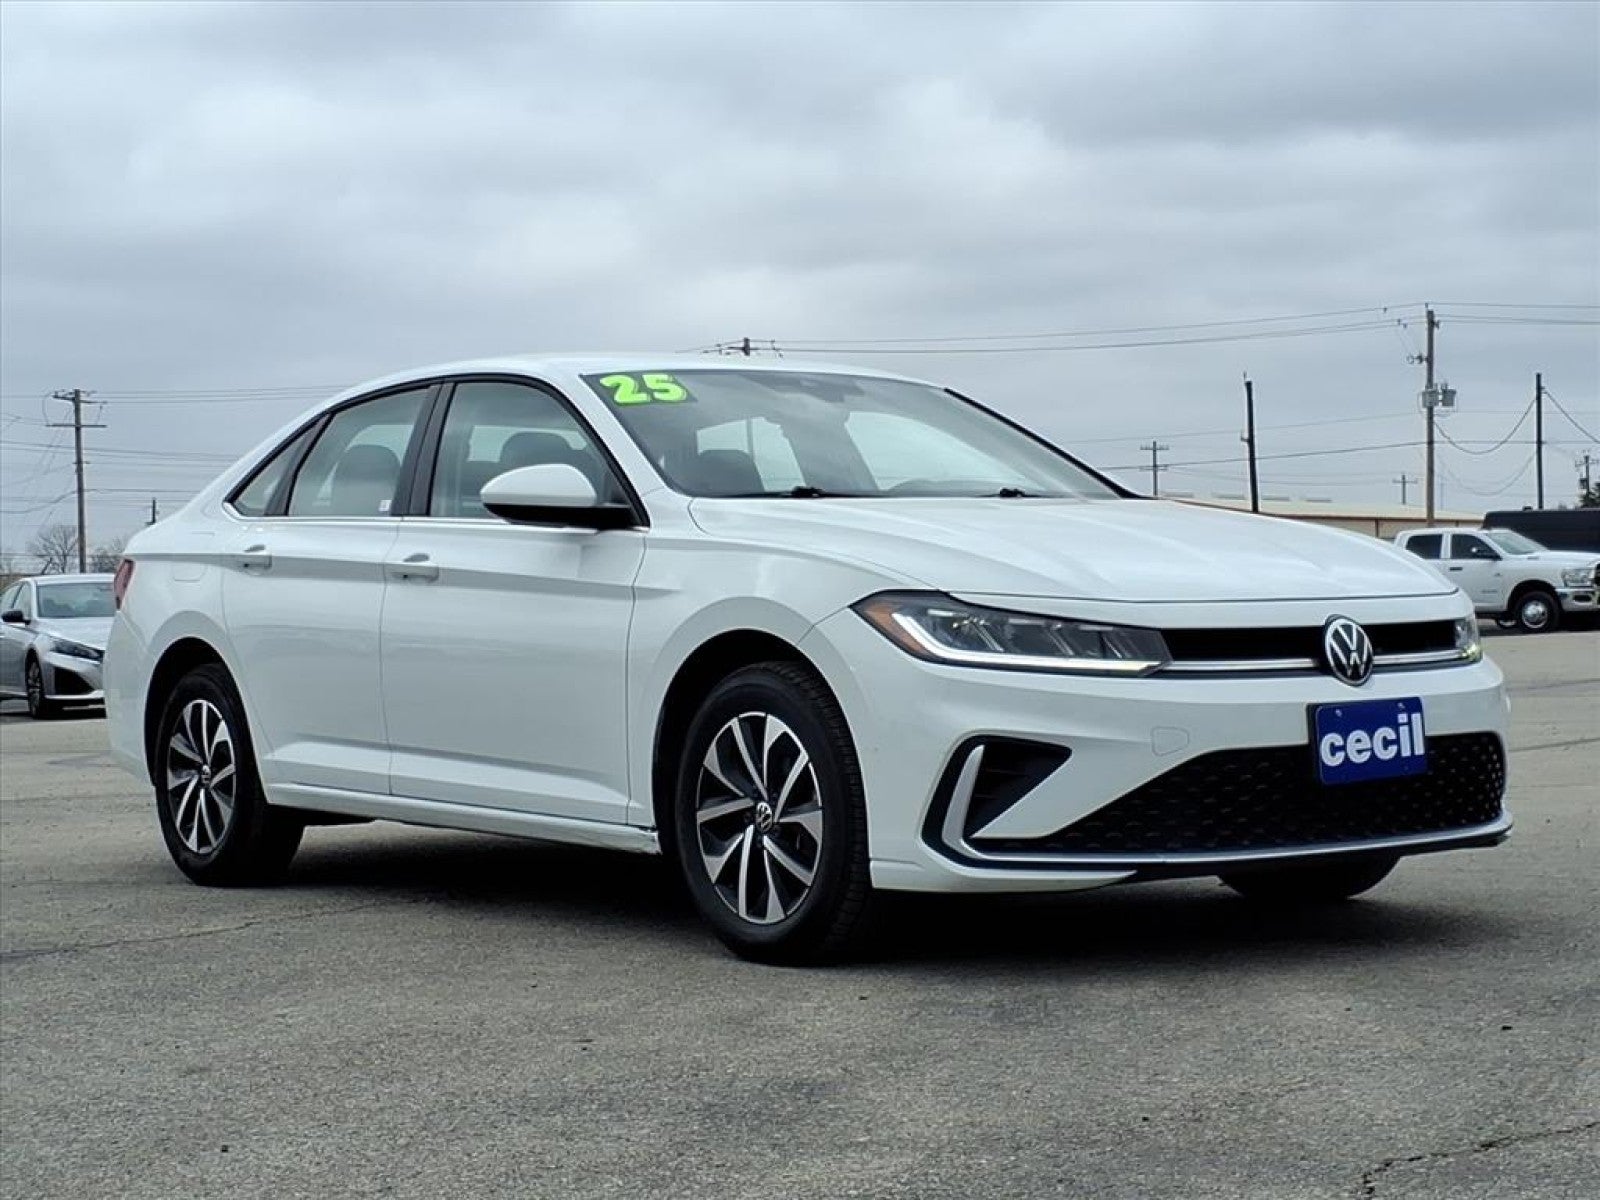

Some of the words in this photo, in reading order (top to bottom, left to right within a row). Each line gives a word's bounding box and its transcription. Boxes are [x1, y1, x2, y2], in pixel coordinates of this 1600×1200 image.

[600, 374, 687, 403] 25
[1328, 620, 1372, 682] VW
[1320, 712, 1425, 767] cecil
